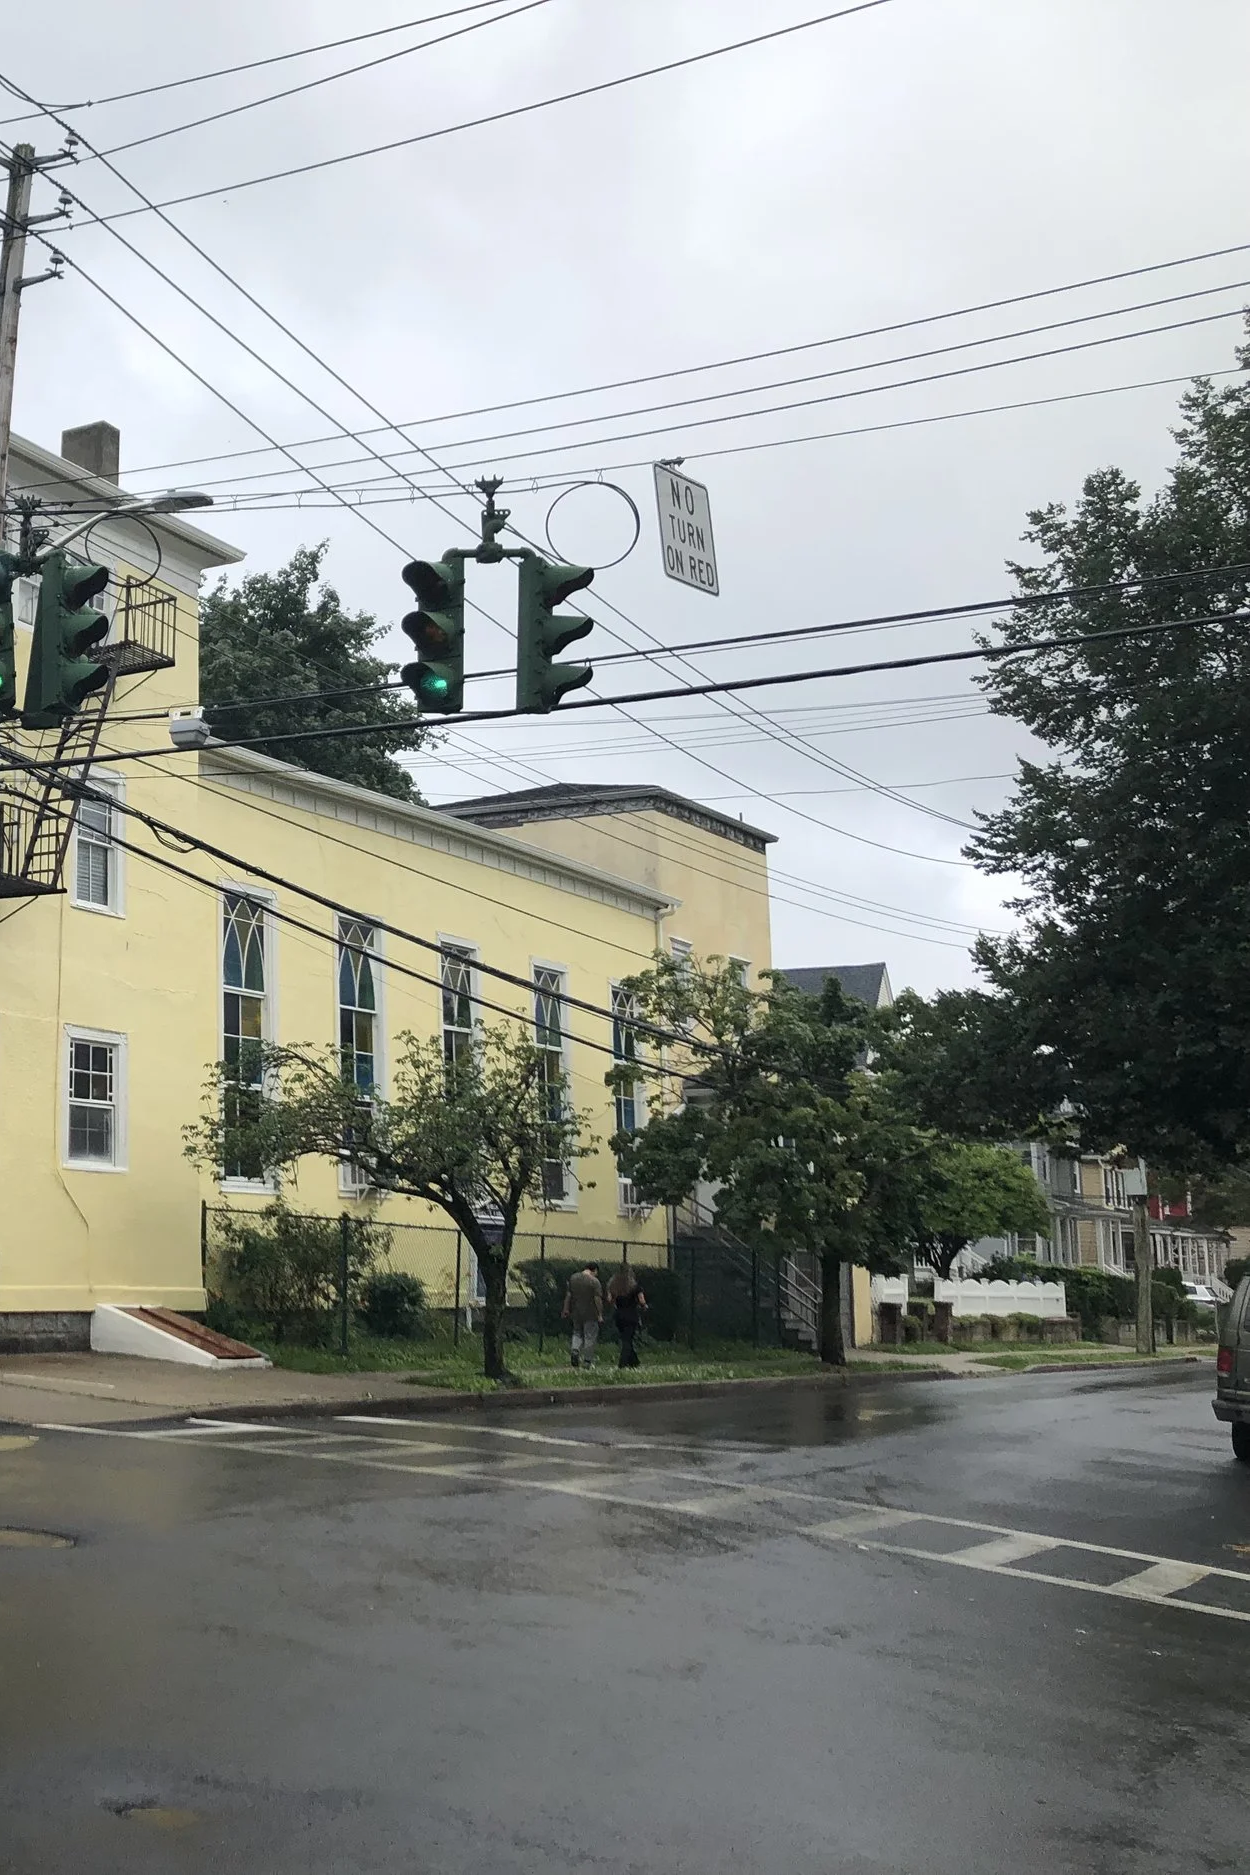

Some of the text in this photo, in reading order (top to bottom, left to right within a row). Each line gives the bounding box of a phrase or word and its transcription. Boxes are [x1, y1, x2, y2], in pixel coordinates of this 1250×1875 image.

[670, 477, 695, 516] NO
[668, 513, 706, 553] TURN
[666, 544, 715, 588] ON RED
